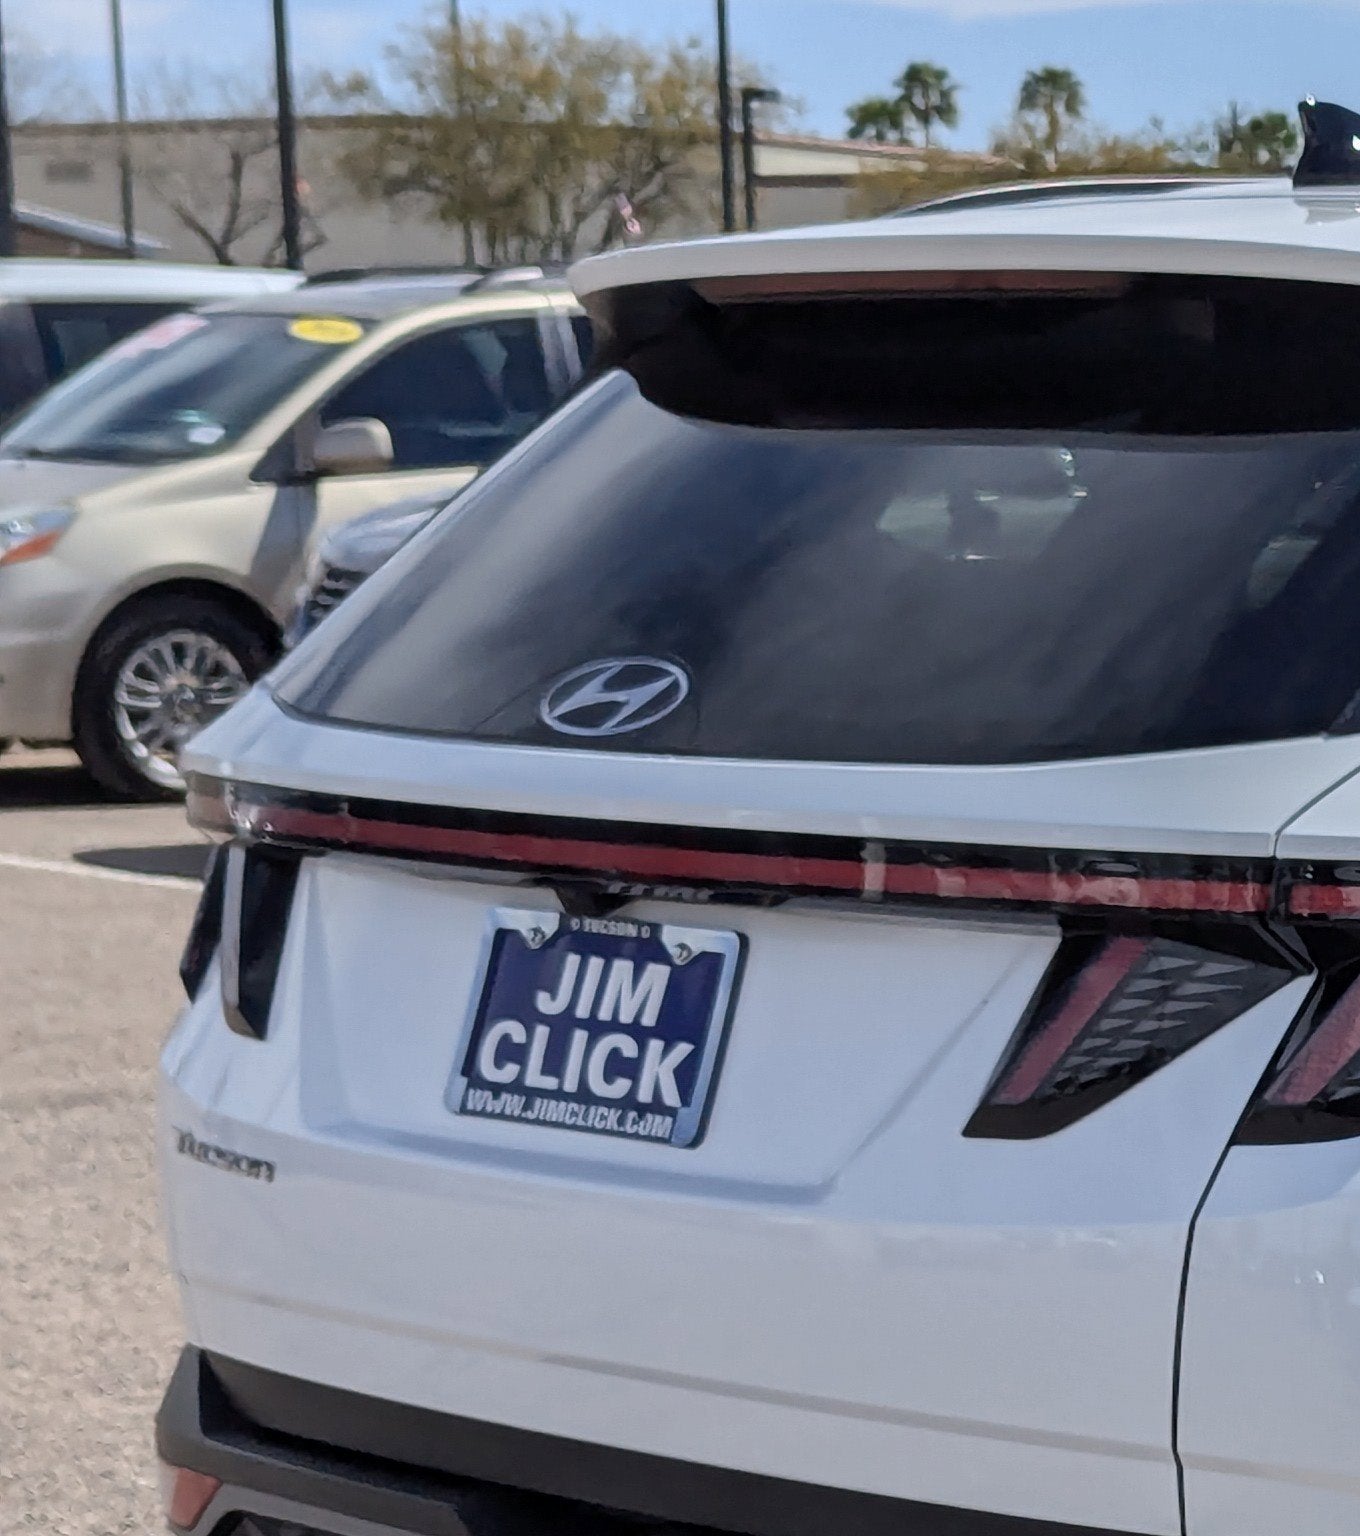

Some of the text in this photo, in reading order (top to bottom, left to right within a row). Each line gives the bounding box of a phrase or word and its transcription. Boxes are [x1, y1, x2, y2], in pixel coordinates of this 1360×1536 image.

[535, 952, 672, 1027] JIM
[478, 1018, 696, 1109] CLICK
[466, 1087, 674, 1139] WWW.JIMCLICK.COM
